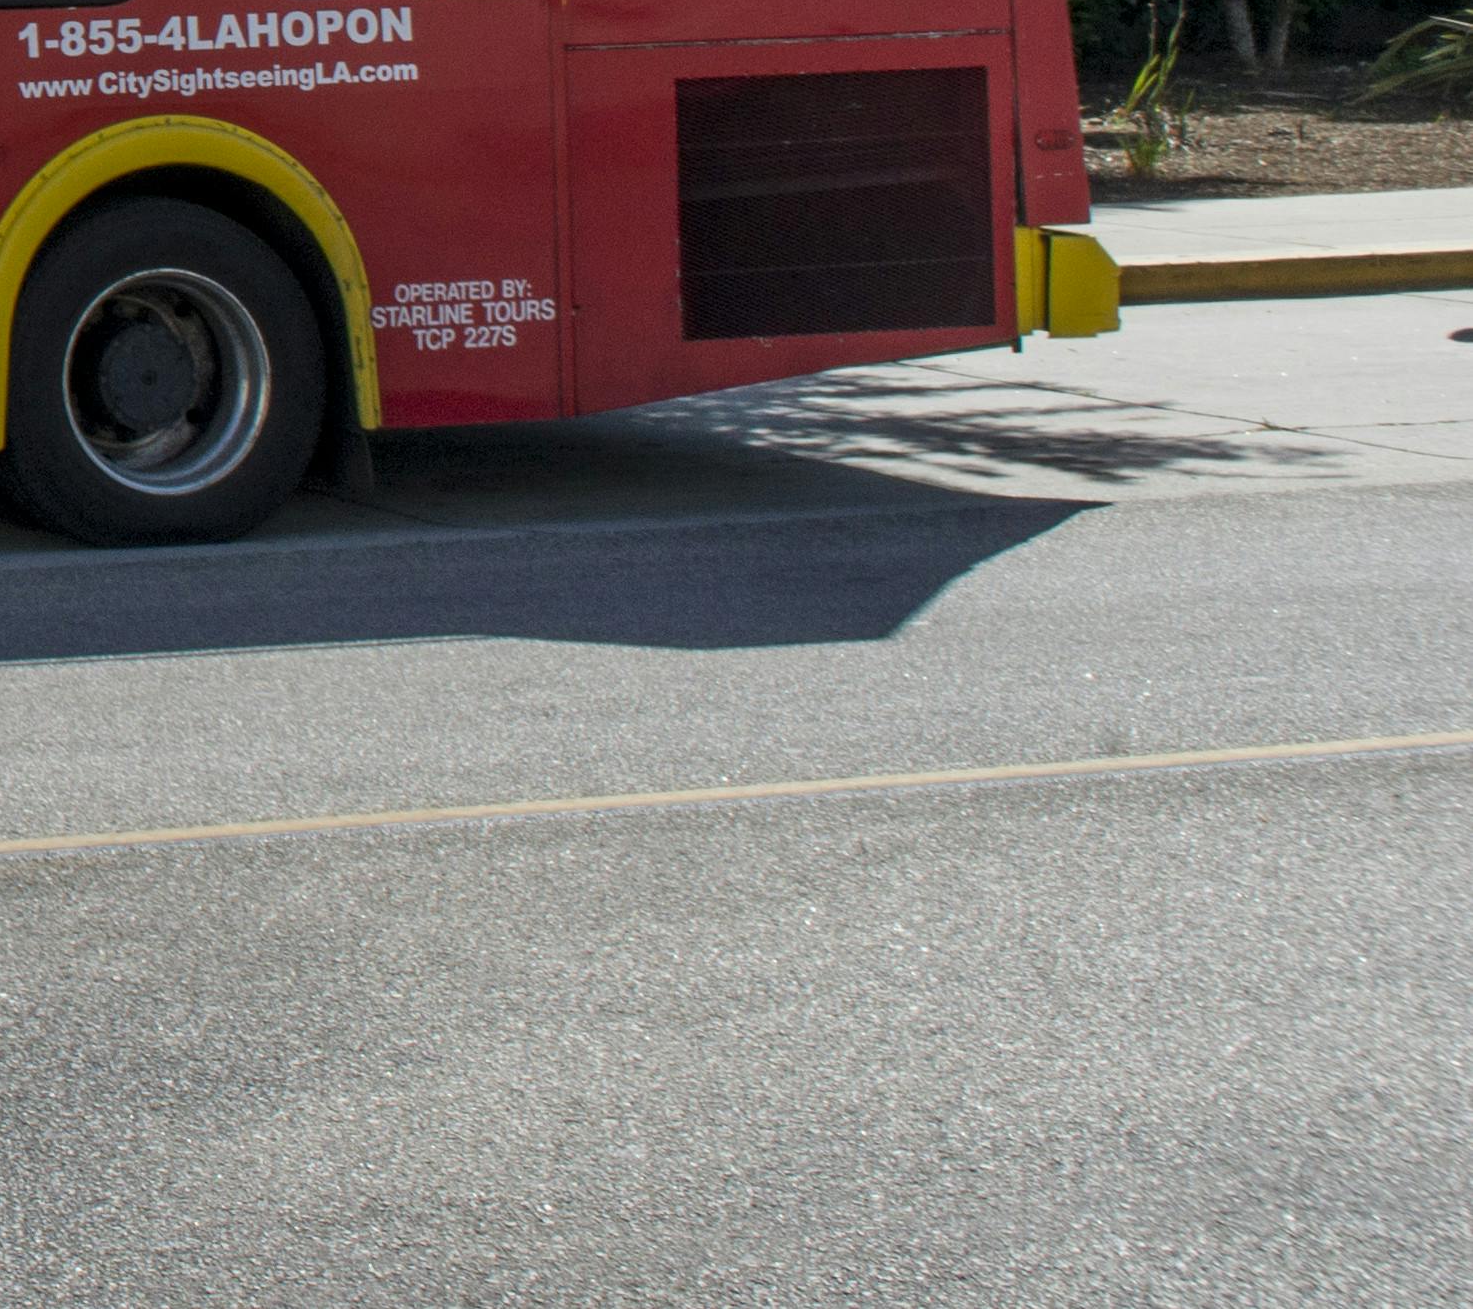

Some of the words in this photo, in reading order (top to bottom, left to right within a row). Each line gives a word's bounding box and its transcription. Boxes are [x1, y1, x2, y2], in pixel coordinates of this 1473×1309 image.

[18, 7, 413, 58] 1-855-4LAHOPON
[98, 61, 418, 96] CitySightseeingLA.com
[394, 281, 494, 303] OPERATED
[502, 279, 532, 298] BY:
[371, 303, 474, 329] STARLINE
[483, 299, 556, 323] TOURS
[413, 328, 457, 351] TCP
